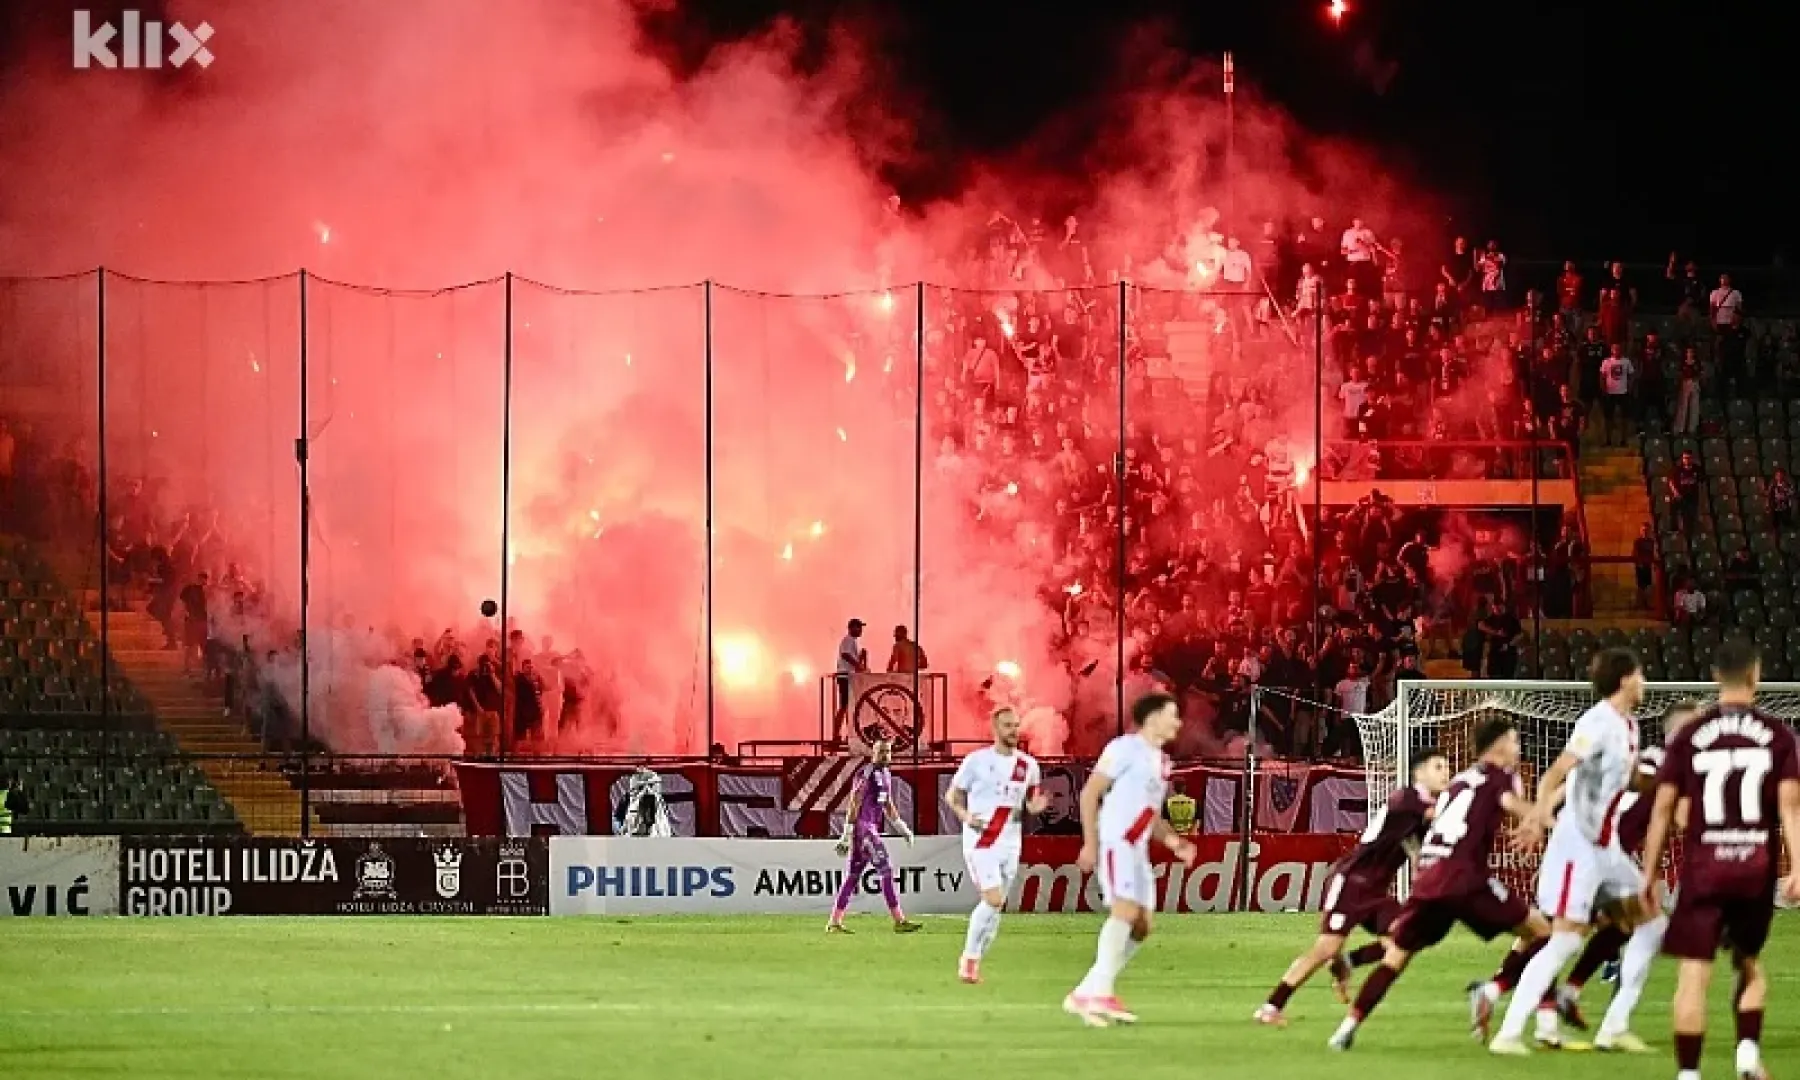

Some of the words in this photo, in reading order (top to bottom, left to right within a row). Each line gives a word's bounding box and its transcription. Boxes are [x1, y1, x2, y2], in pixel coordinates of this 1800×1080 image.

[1692, 747, 1773, 825] 77
[127, 848, 231, 882] HOTELI
[242, 842, 339, 882] ILIDŽA
[8, 875, 89, 916] VIĆ
[566, 866, 735, 897] PHILIPS
[754, 866, 926, 897] AMBILGHT
[934, 867, 964, 893] tv
[127, 886, 232, 916] GROUP
